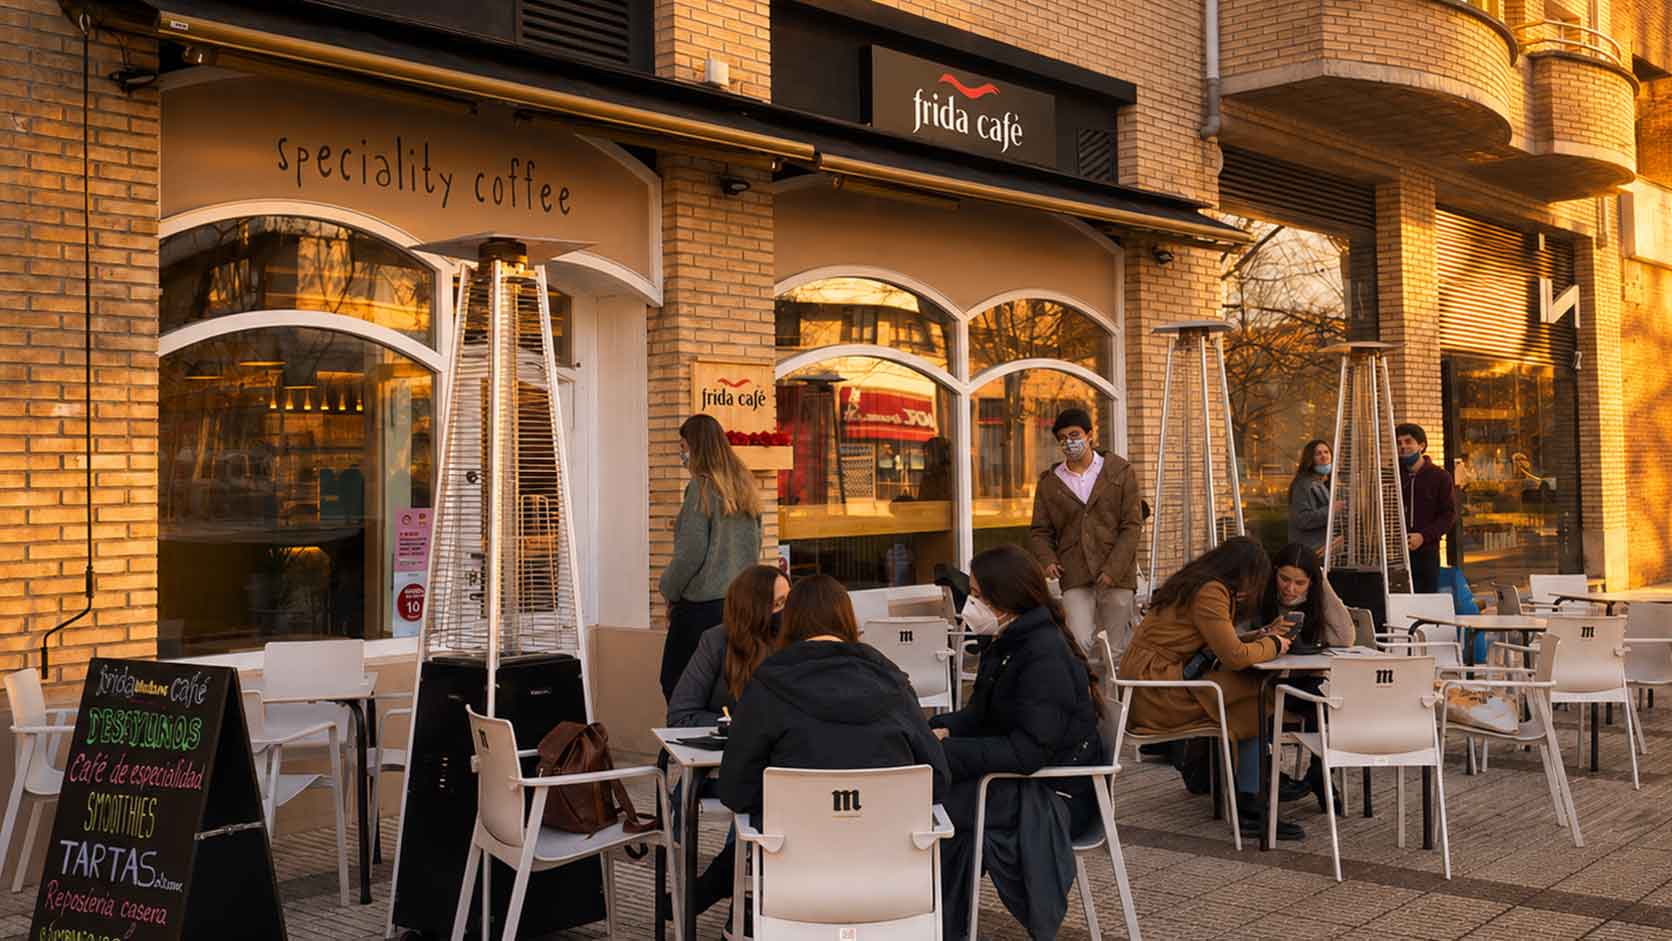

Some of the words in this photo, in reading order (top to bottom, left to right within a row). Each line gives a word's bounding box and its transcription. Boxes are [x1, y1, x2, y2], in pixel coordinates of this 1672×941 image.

[912, 88, 969, 135] frida
[977, 111, 1023, 153] café
[277, 136, 454, 209] speciality
[475, 157, 571, 216] coffee
[702, 387, 733, 411] frida
[738, 389, 766, 411] café
[406, 600, 421, 615] 10
[96, 664, 135, 698] frida
[170, 671, 213, 709] café
[69, 752, 108, 785] Café
[110, 752, 129, 785] de
[130, 758, 206, 791] especialidad
[83, 791, 158, 839] SMOOTHIES
[832, 789, 863, 811] m
[59, 839, 159, 888] TARTAS
[120, 900, 168, 926] casera
